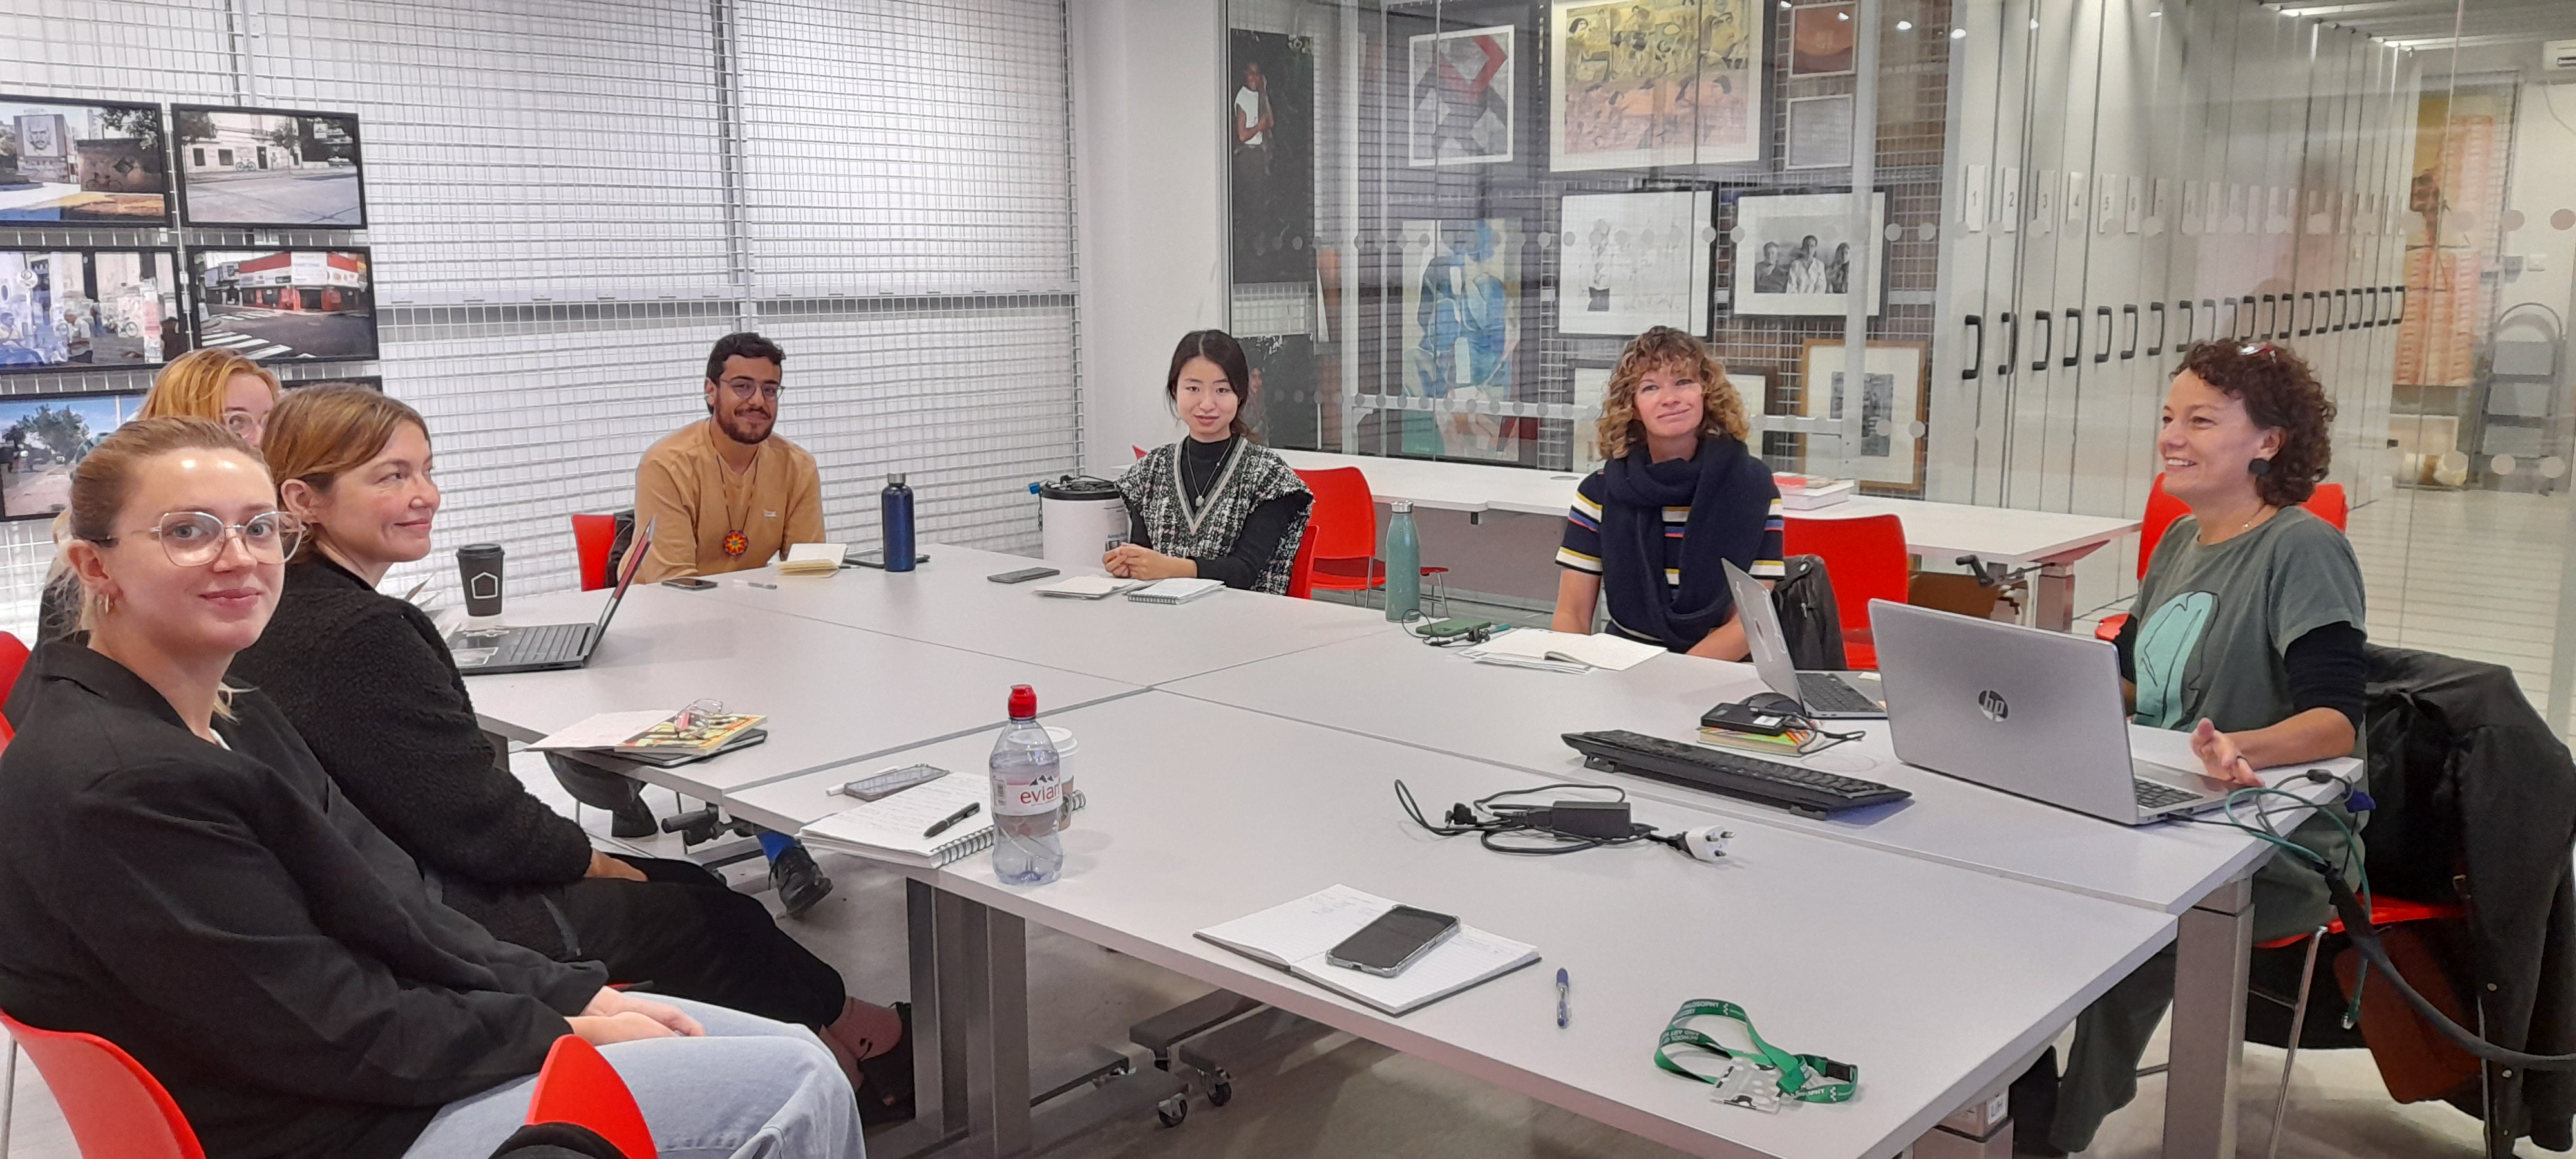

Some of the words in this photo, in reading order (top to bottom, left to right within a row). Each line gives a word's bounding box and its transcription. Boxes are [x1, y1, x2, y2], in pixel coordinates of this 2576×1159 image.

[2009, 192, 2015, 207] 2
[2043, 194, 2048, 209] 3
[2074, 194, 2079, 207] 4
[2104, 196, 2110, 211] 5
[1020, 783, 1060, 804] evian
